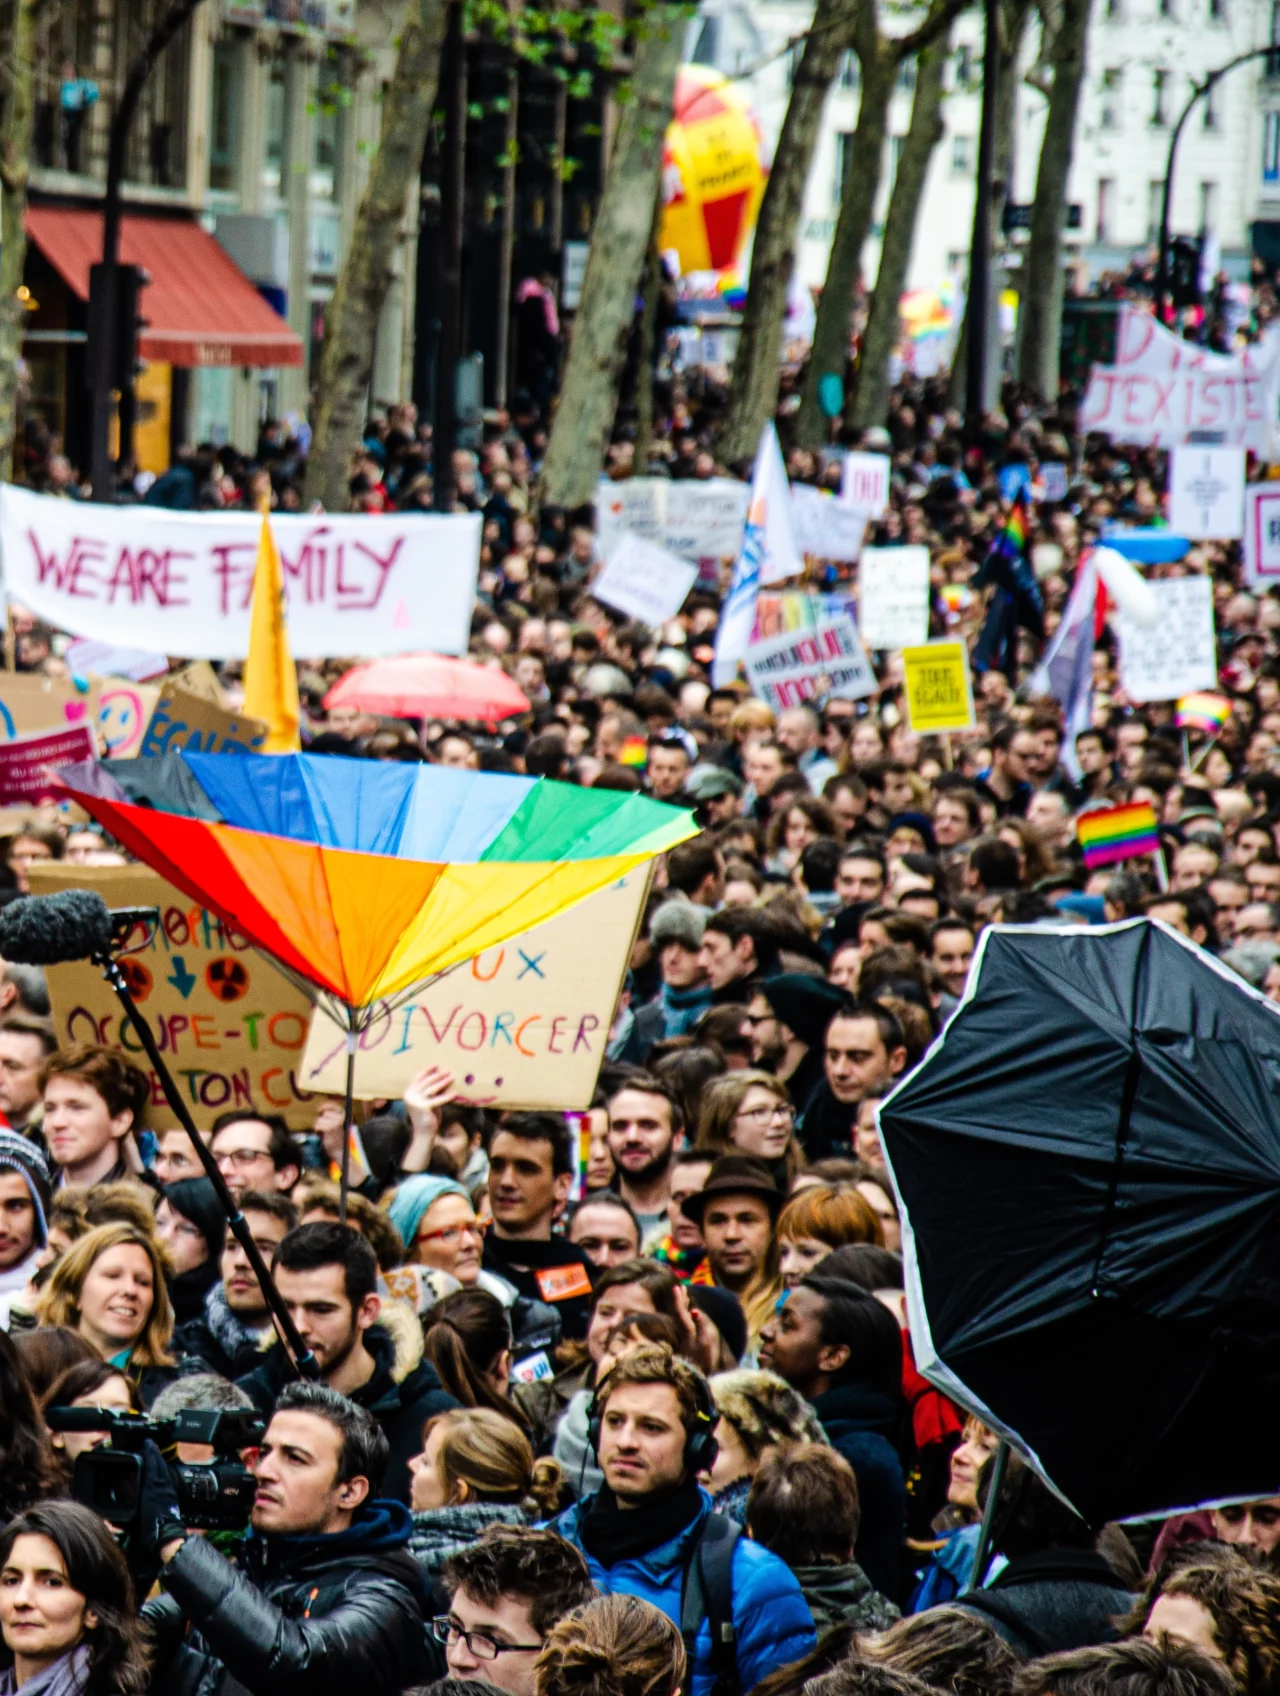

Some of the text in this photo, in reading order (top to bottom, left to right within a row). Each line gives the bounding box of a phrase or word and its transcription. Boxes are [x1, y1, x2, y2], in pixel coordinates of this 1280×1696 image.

[106, 546, 197, 608] ARE
[66, 1005, 310, 1055] OCCUPE-TO
[357, 997, 601, 1058] DIVORCER
[177, 1066, 257, 1108] TON
[260, 1066, 314, 1108] CU
